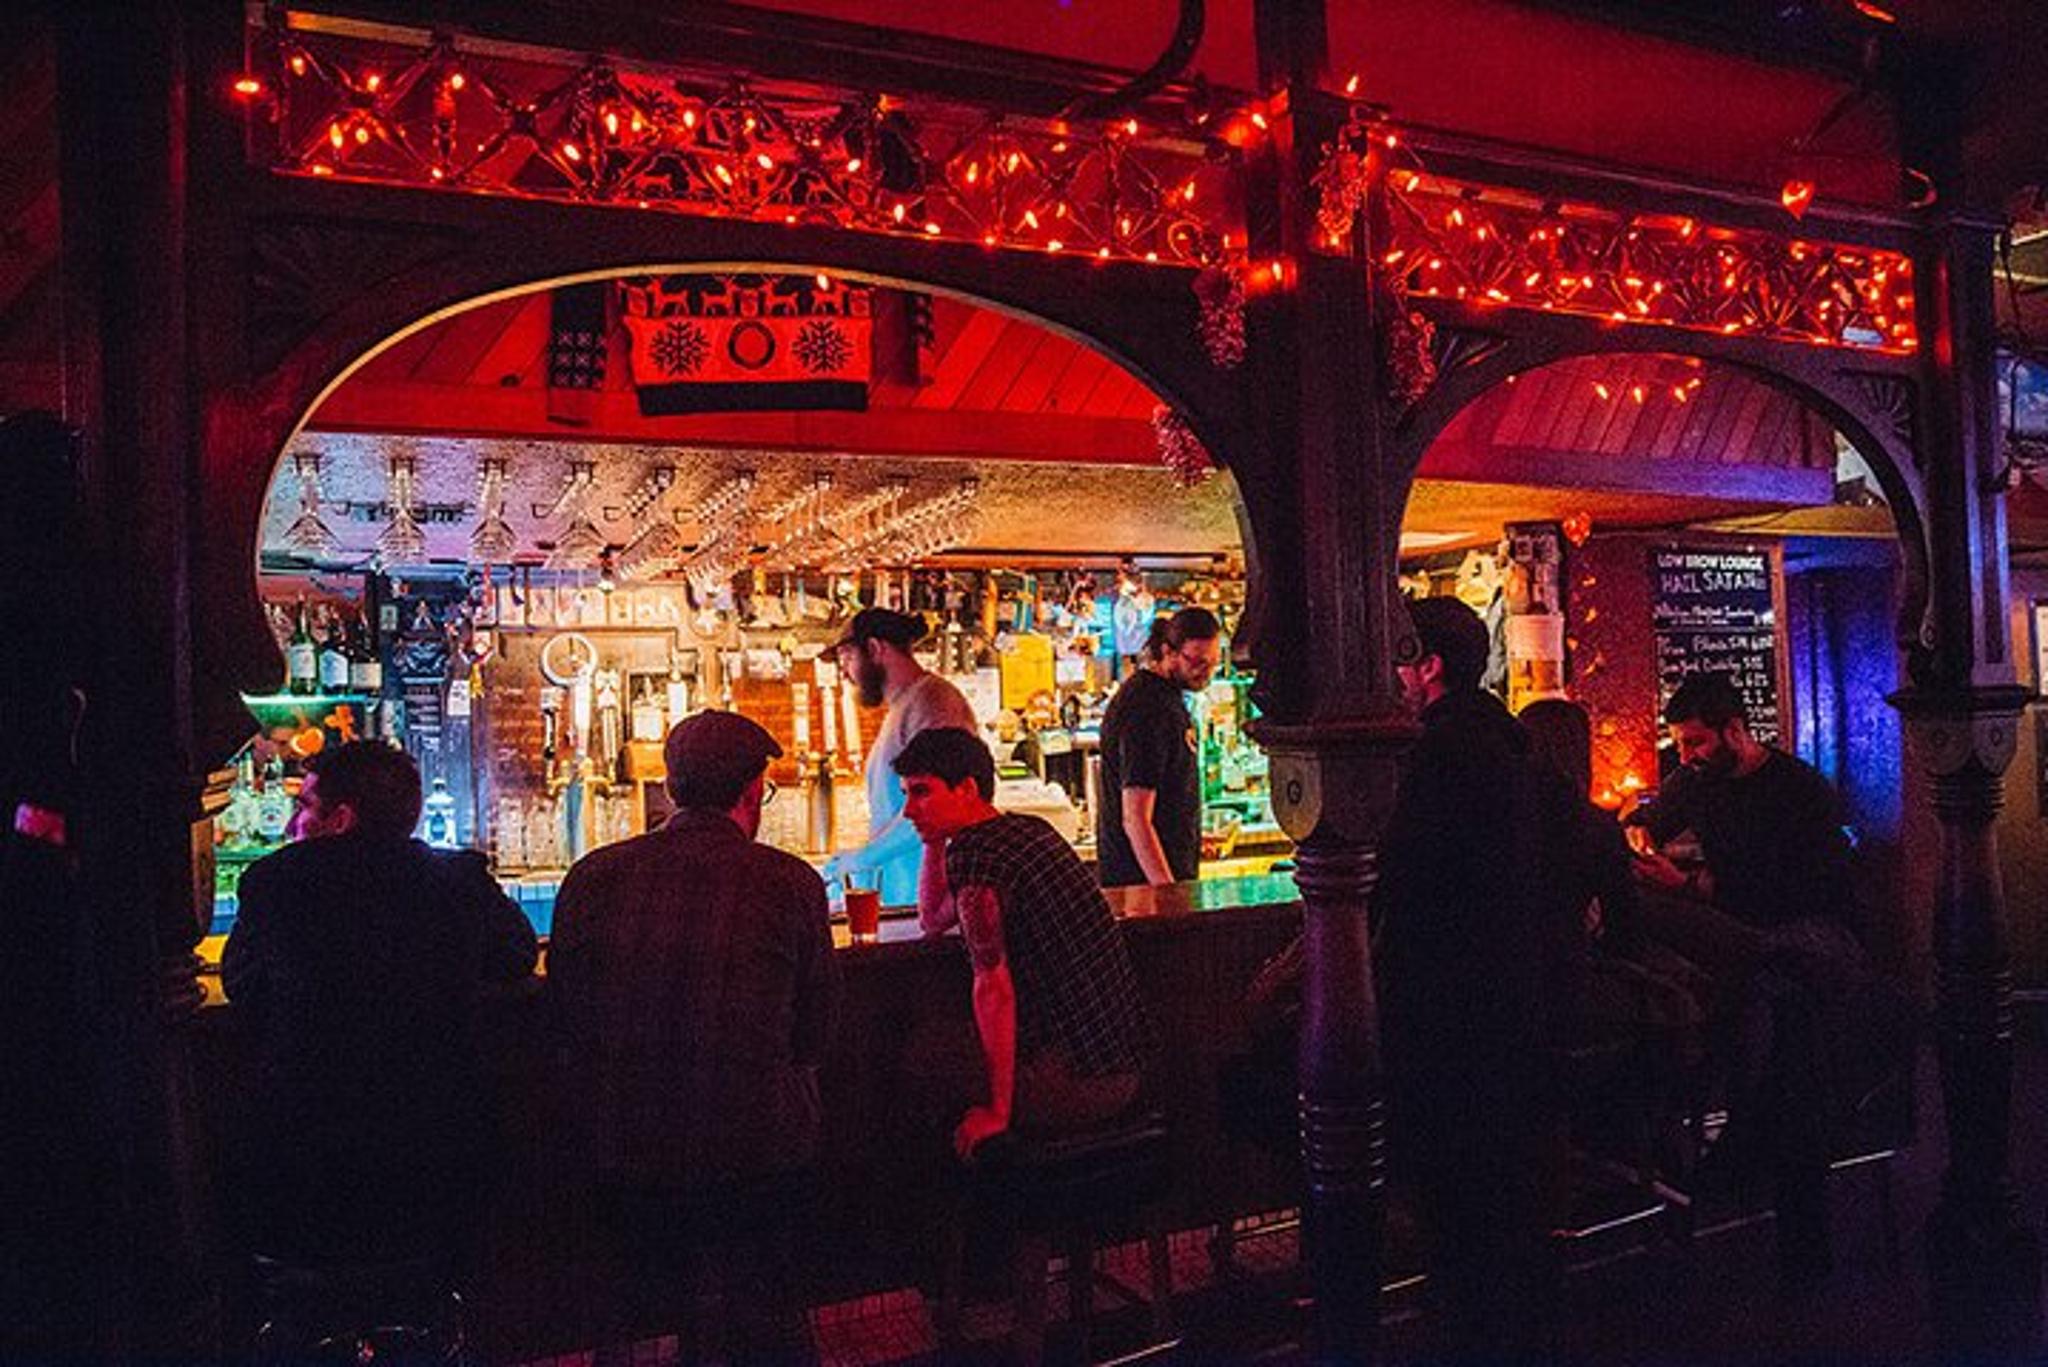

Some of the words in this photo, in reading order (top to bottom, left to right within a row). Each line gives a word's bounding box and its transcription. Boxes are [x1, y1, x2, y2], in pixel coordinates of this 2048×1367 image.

[1657, 555, 1684, 568] LOW
[1686, 555, 1718, 569] BROW
[1720, 556, 1764, 571] LOUNGE
[1661, 573, 1701, 593] HAIL
